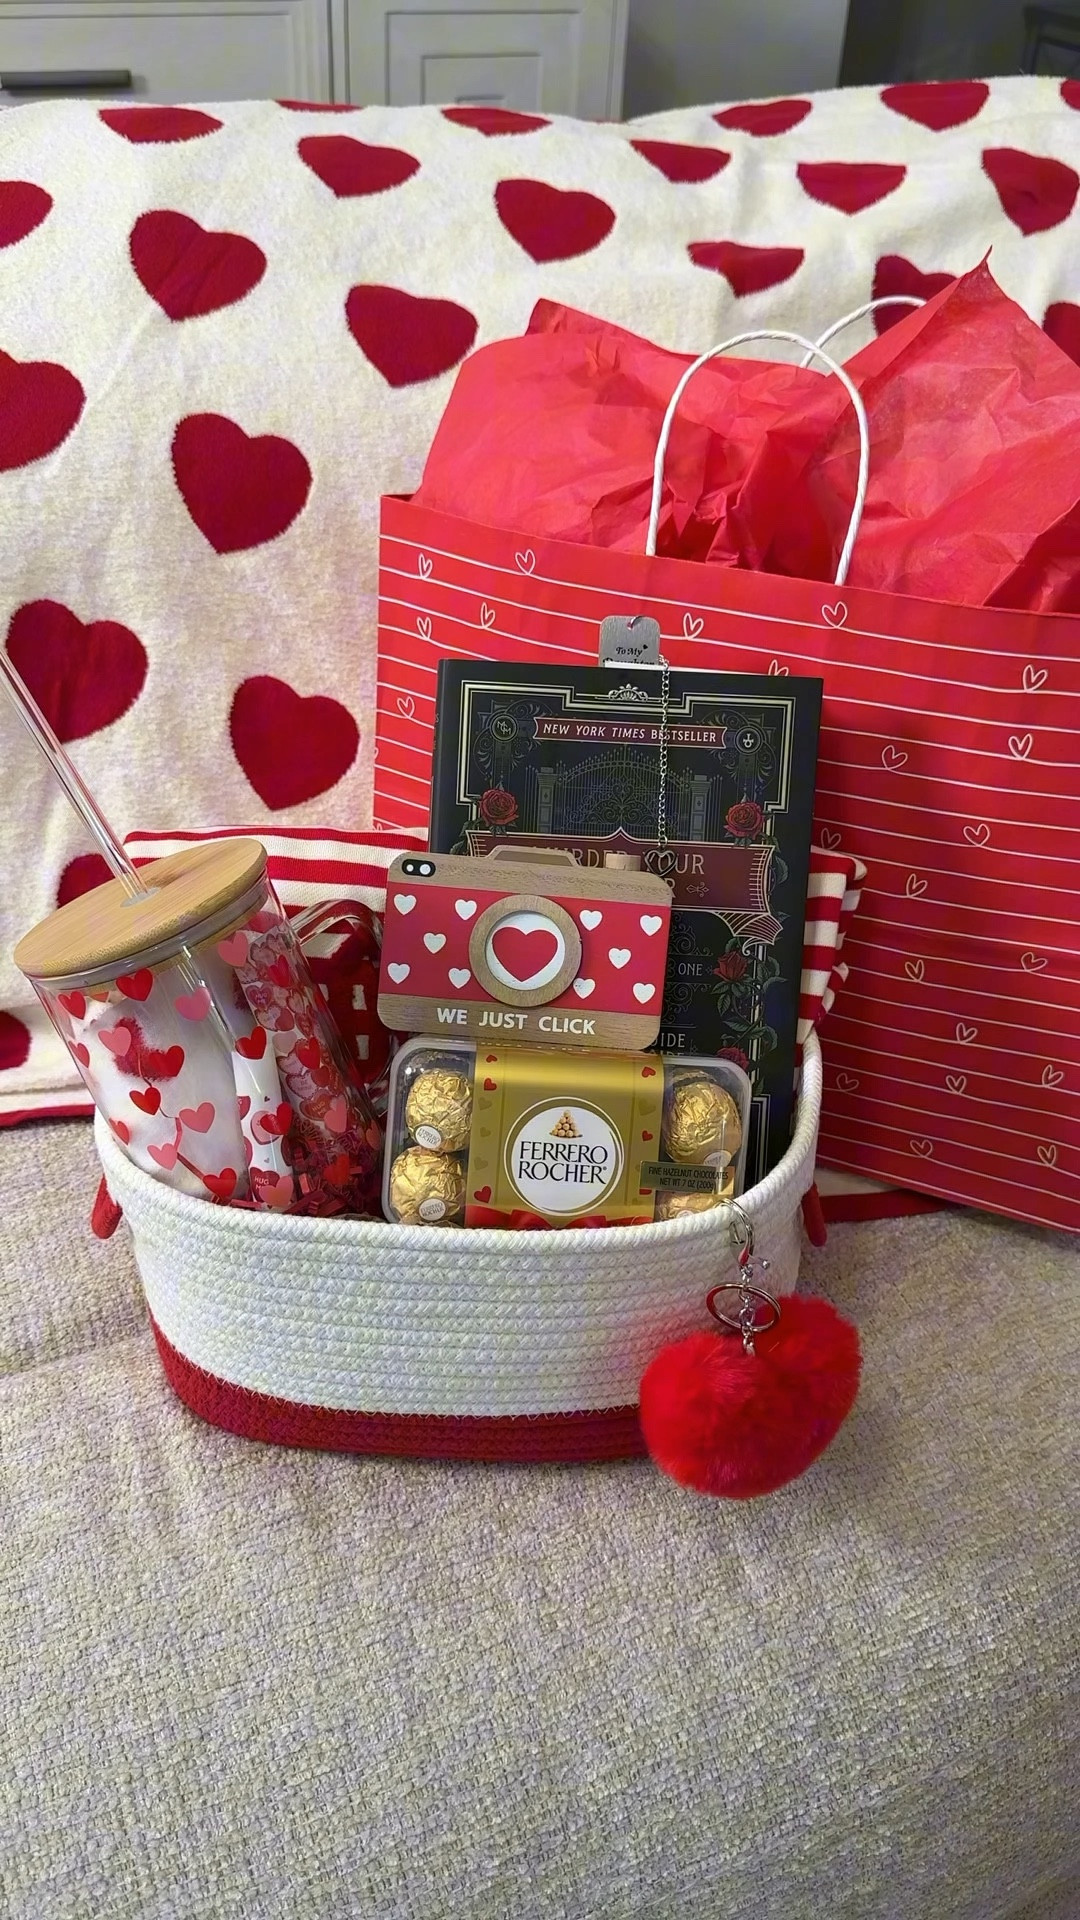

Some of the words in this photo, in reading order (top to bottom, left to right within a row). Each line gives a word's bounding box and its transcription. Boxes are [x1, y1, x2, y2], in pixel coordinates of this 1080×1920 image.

[615, 646, 627, 655] To
[627, 647, 643, 657] My
[543, 723, 570, 735] NEW
[576, 725, 606, 737] YORK
[612, 727, 646, 739] TIMES
[651, 729, 717, 742] BESTSELLER
[678, 963, 703, 976] ONE
[436, 1007, 468, 1025] WE
[478, 1011, 529, 1030] JUST
[538, 1016, 596, 1035] CLICK
[519, 1141, 608, 1164] FERRERO
[648, 1166, 661, 1175] FINE
[663, 1167, 692, 1178] HAZELNUT
[693, 1169, 729, 1180] CHOCOLATES
[254, 1176, 270, 1185] HUG
[660, 1177, 671, 1186] NET
[672, 1178, 681, 1187] WT
[687, 1179, 695, 1188] OZ
